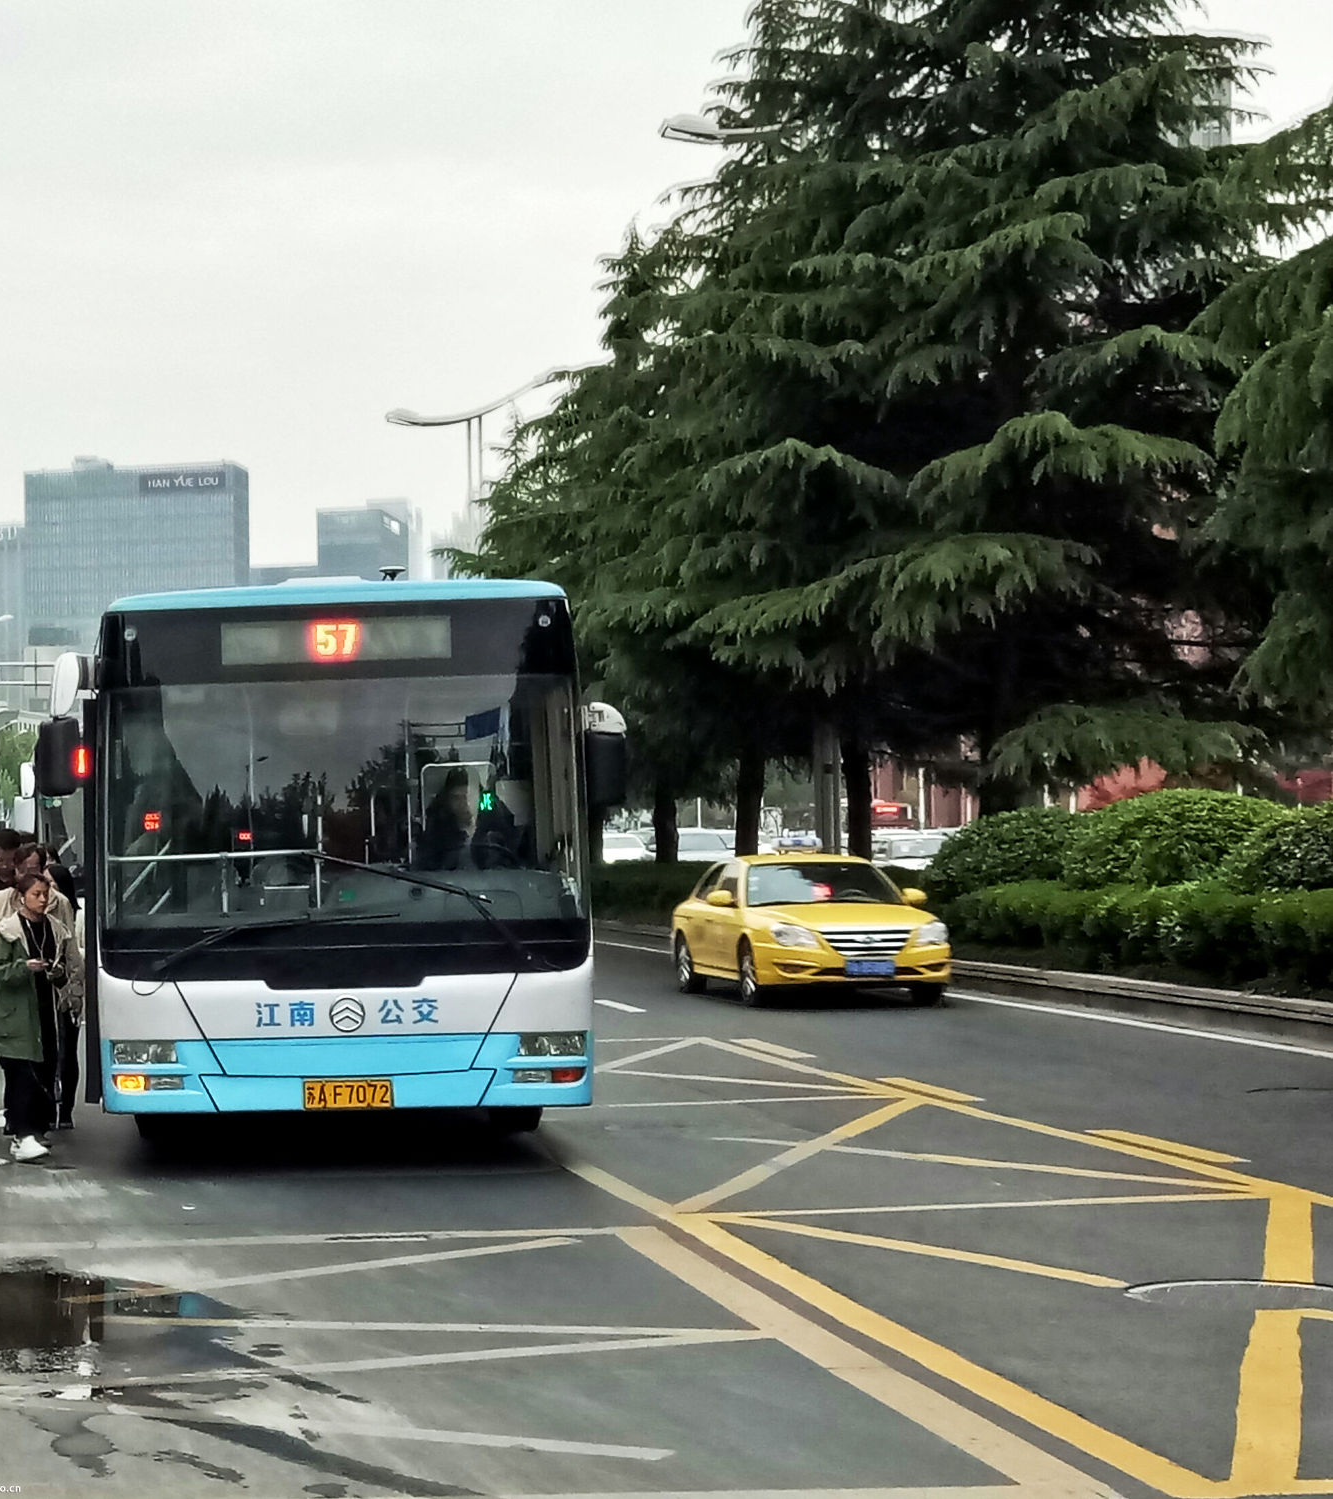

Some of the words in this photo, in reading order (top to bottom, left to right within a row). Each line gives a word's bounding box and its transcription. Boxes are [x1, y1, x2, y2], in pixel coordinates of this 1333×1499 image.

[173, 475, 194, 487] YUE
[198, 476, 219, 487] LOU
[315, 624, 357, 656] 57
[255, 1001, 315, 1027] 江南
[378, 998, 439, 1024] 公交
